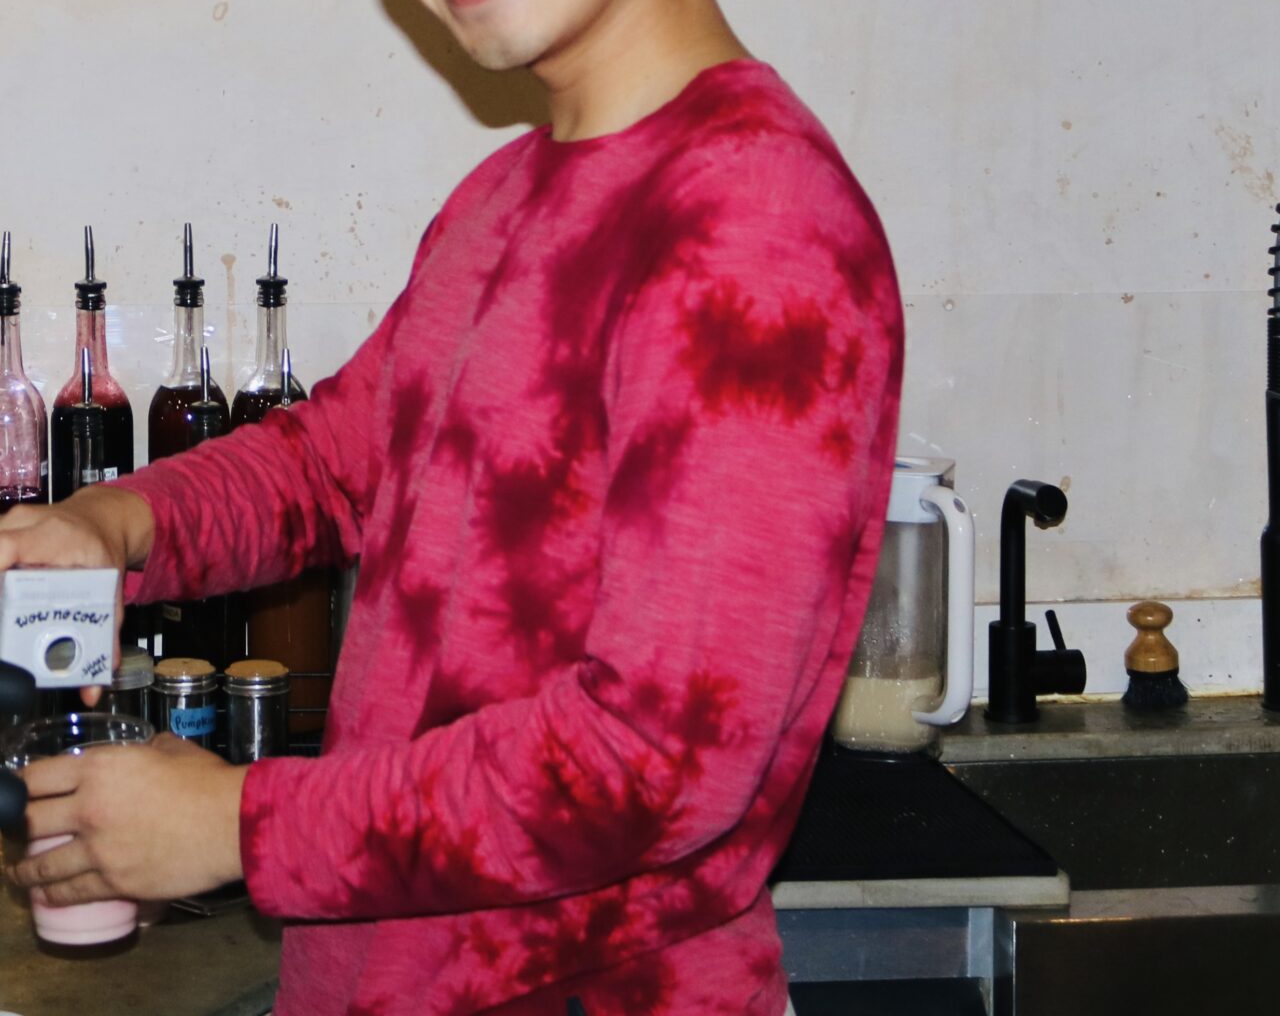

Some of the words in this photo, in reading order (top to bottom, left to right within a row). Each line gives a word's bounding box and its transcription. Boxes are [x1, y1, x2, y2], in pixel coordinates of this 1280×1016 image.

[15, 610, 49, 628] wow
[53, 609, 70, 621] no
[72, 610, 109, 627] cow!
